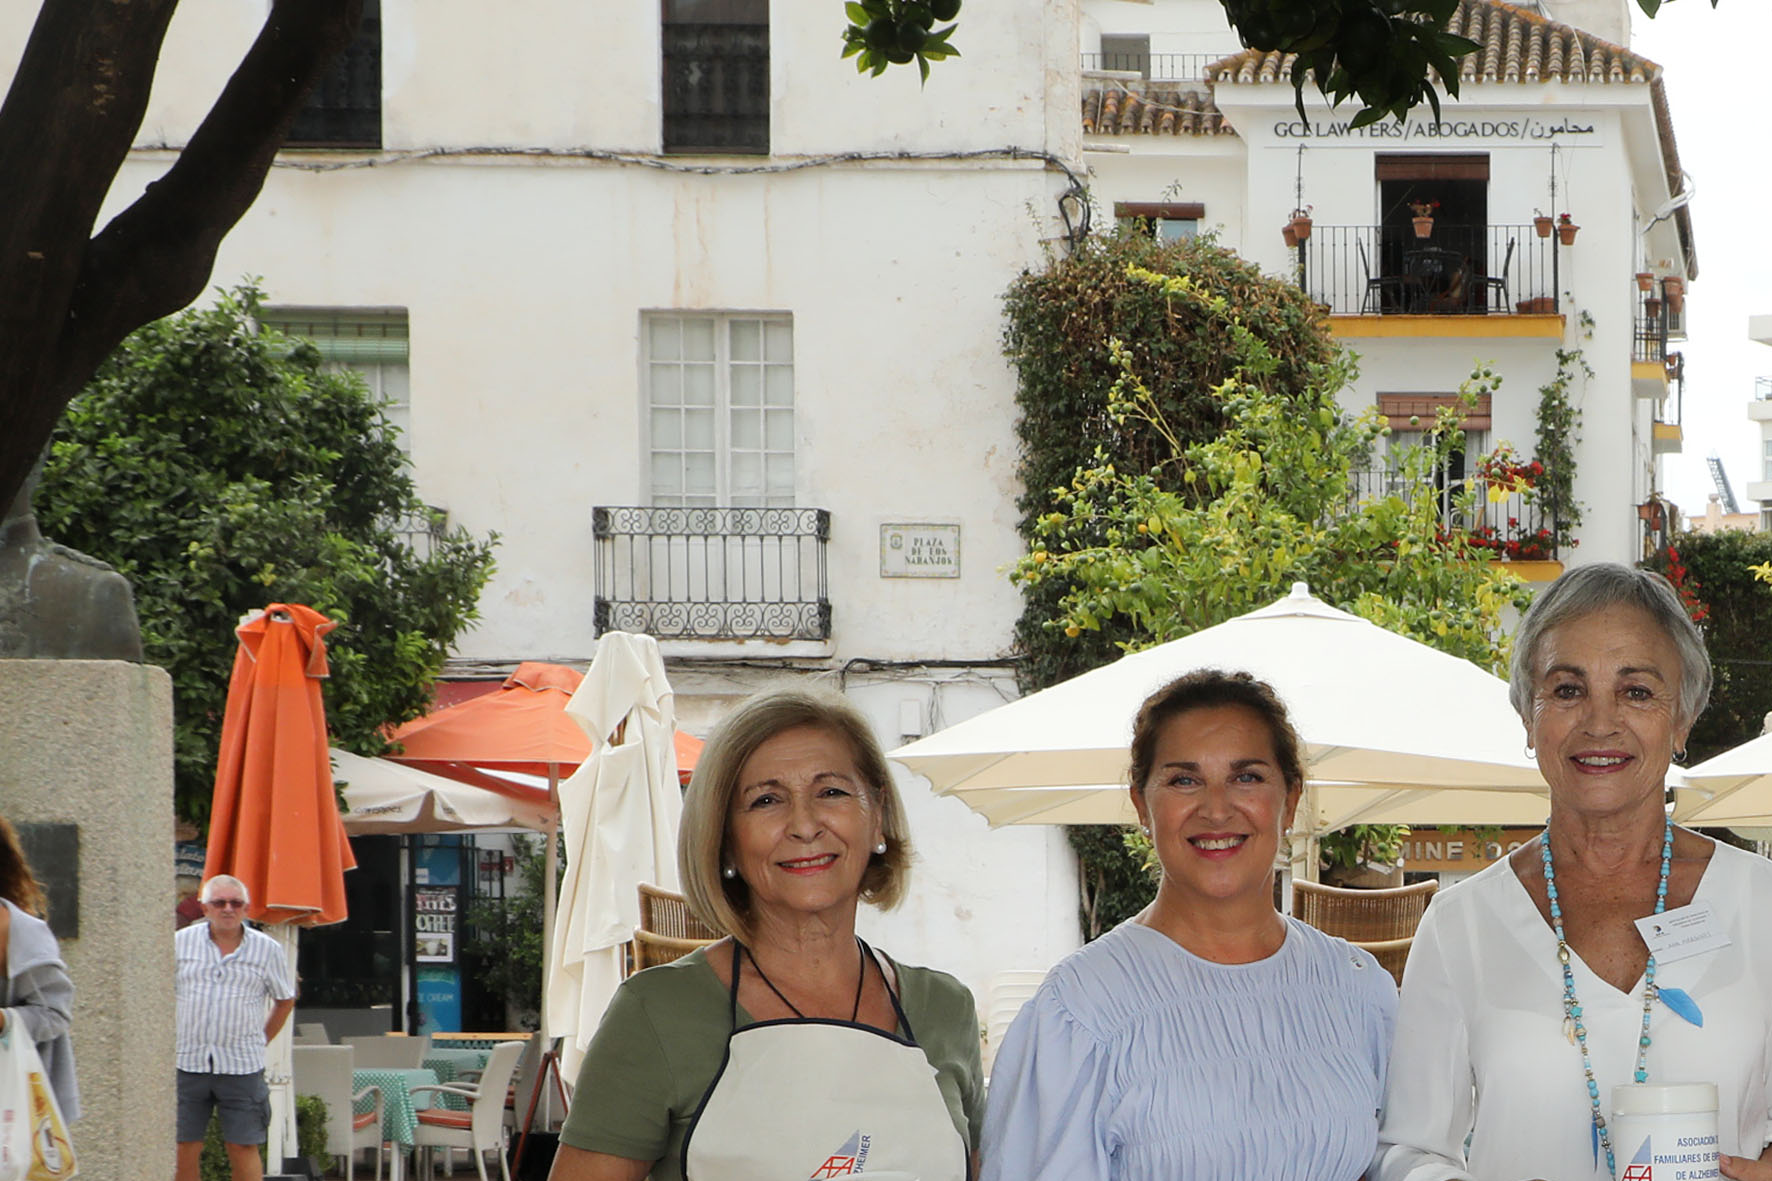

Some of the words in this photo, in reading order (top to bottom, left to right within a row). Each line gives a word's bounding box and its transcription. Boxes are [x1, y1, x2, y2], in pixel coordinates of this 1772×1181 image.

[913, 537, 943, 546] PLAZA
[911, 547, 920, 555] DE
[905, 556, 952, 565] NARANJOS
[416, 914, 456, 933] OFFEE
[853, 1134, 872, 1174] ZHEIMER
[1654, 1153, 1701, 1165] FAMILIARES
[1675, 1171, 1687, 1181] DE
